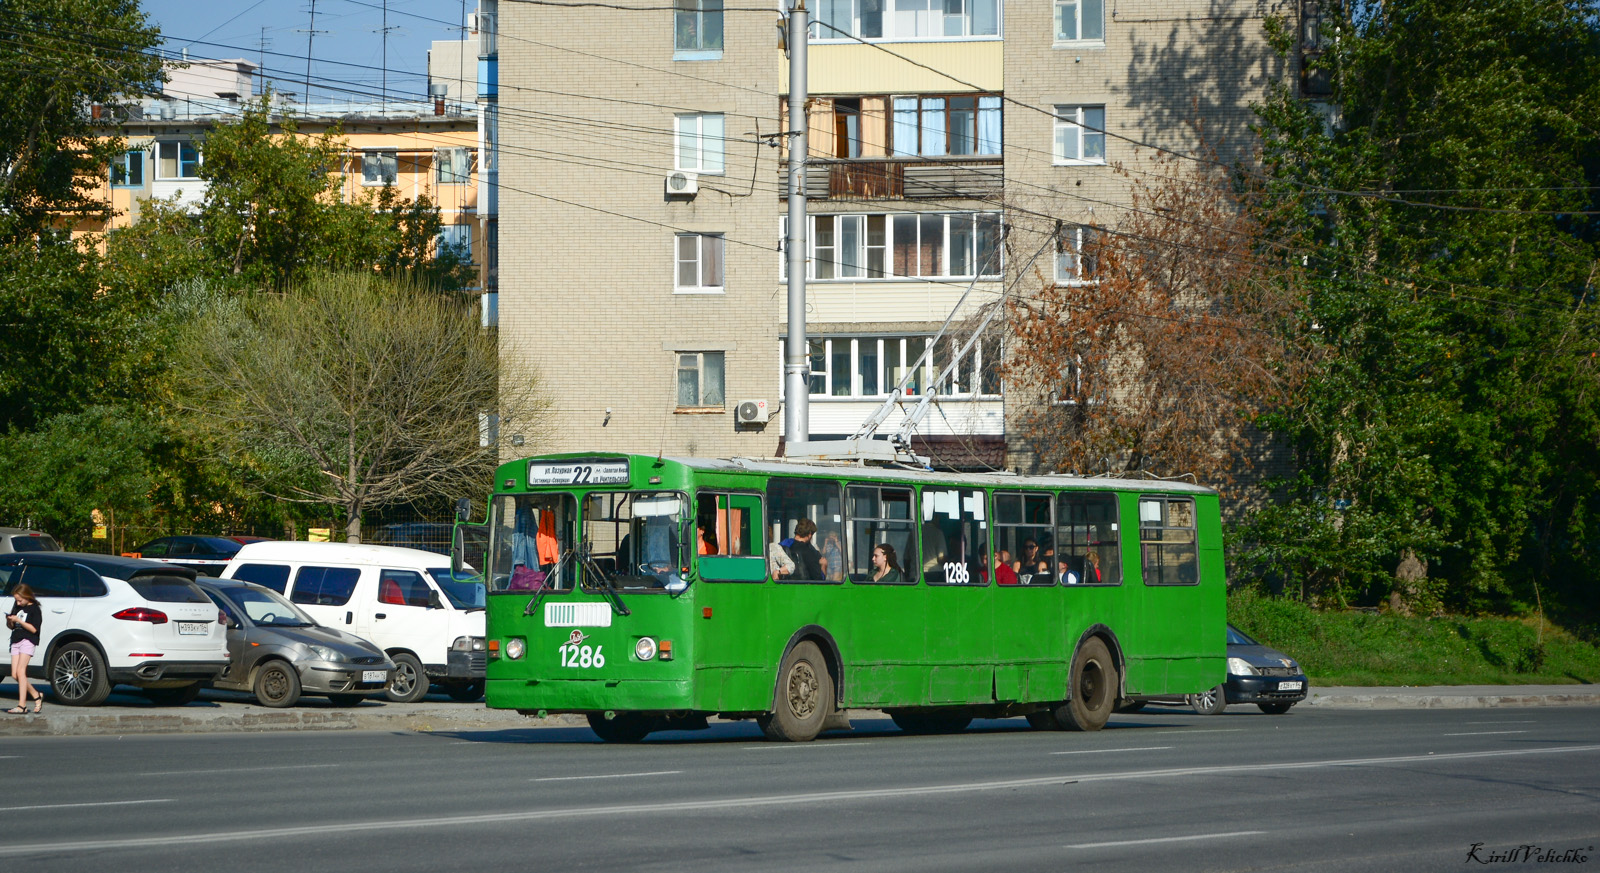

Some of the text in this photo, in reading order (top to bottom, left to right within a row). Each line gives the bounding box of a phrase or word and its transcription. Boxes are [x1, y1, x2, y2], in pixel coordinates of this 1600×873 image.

[572, 465, 592, 484] 22
[943, 562, 970, 584] 1286
[559, 645, 605, 669] 1286
